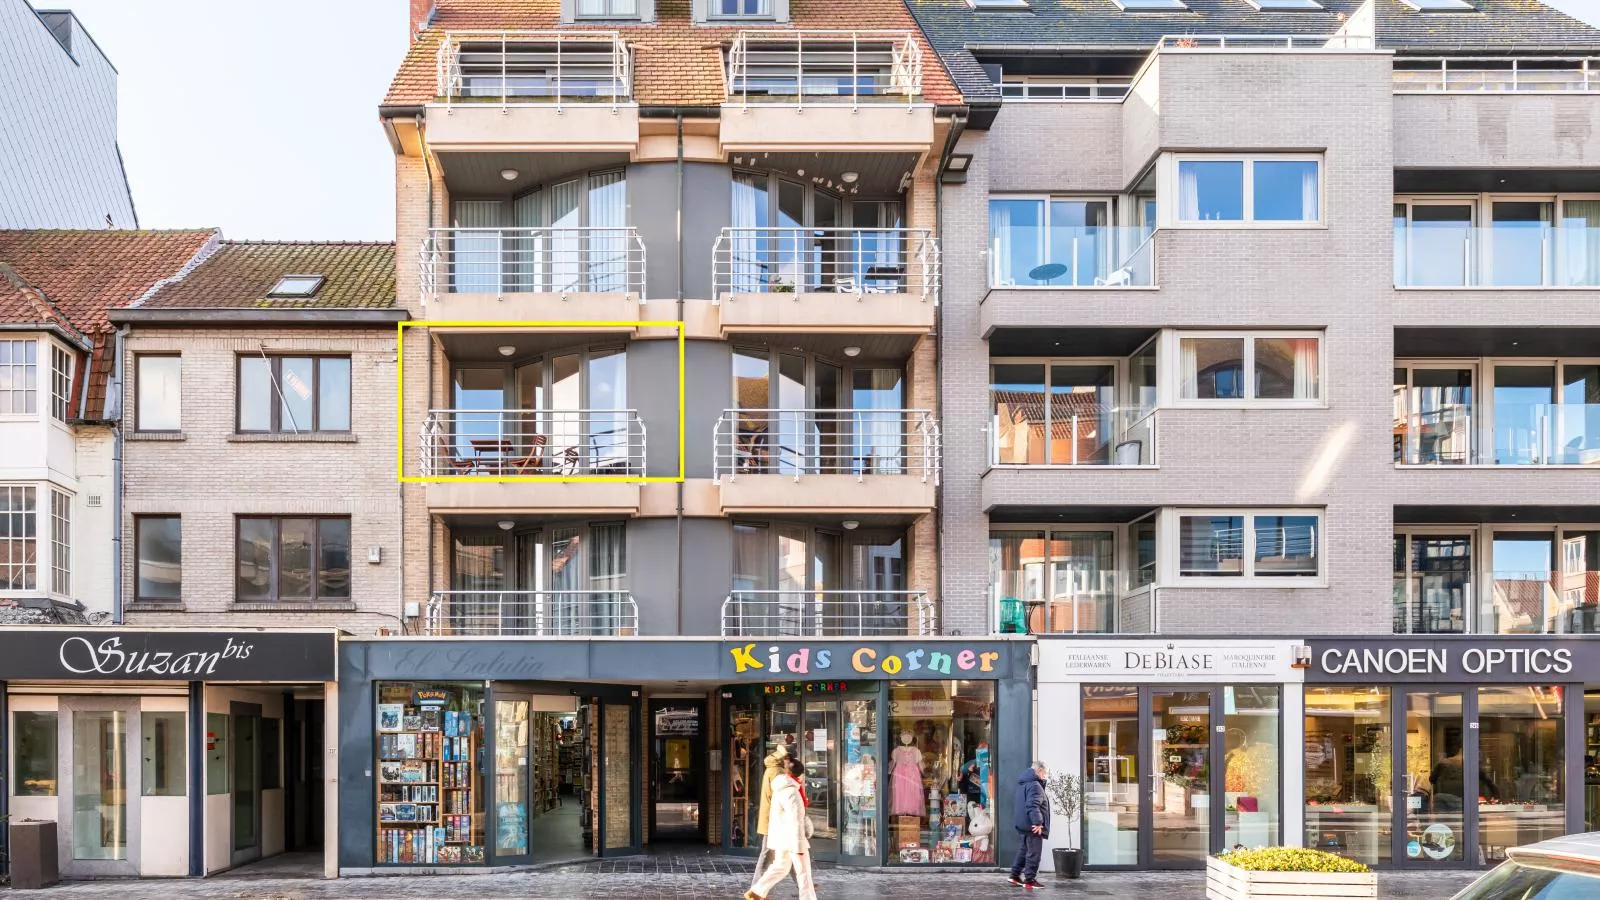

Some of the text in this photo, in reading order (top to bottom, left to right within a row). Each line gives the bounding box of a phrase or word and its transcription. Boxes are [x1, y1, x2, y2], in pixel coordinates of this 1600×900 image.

[60, 636, 254, 674] Suzan bis
[730, 643, 999, 674] Kids Corner
[1321, 648, 1573, 674] CANOEN OPTICS
